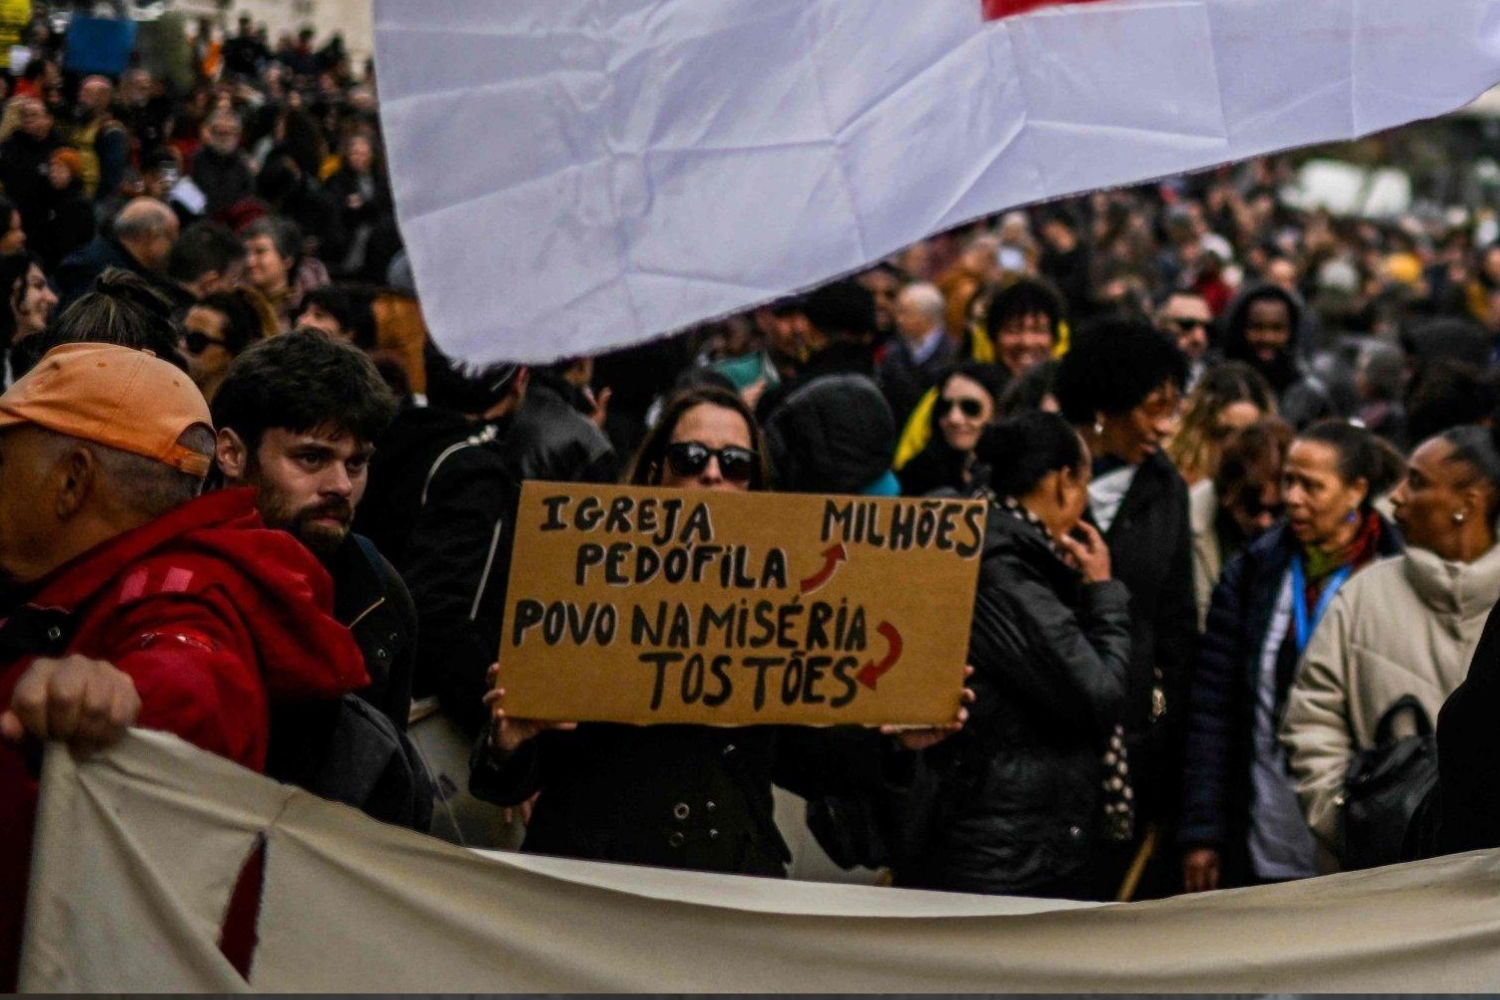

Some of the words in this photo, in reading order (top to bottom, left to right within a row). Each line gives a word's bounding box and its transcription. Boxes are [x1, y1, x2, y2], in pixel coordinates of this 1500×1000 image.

[539, 495, 714, 547] IGREJA
[820, 499, 985, 558] MILHÕES
[575, 541, 788, 590] PEDÓFILA
[511, 600, 618, 648] POVO
